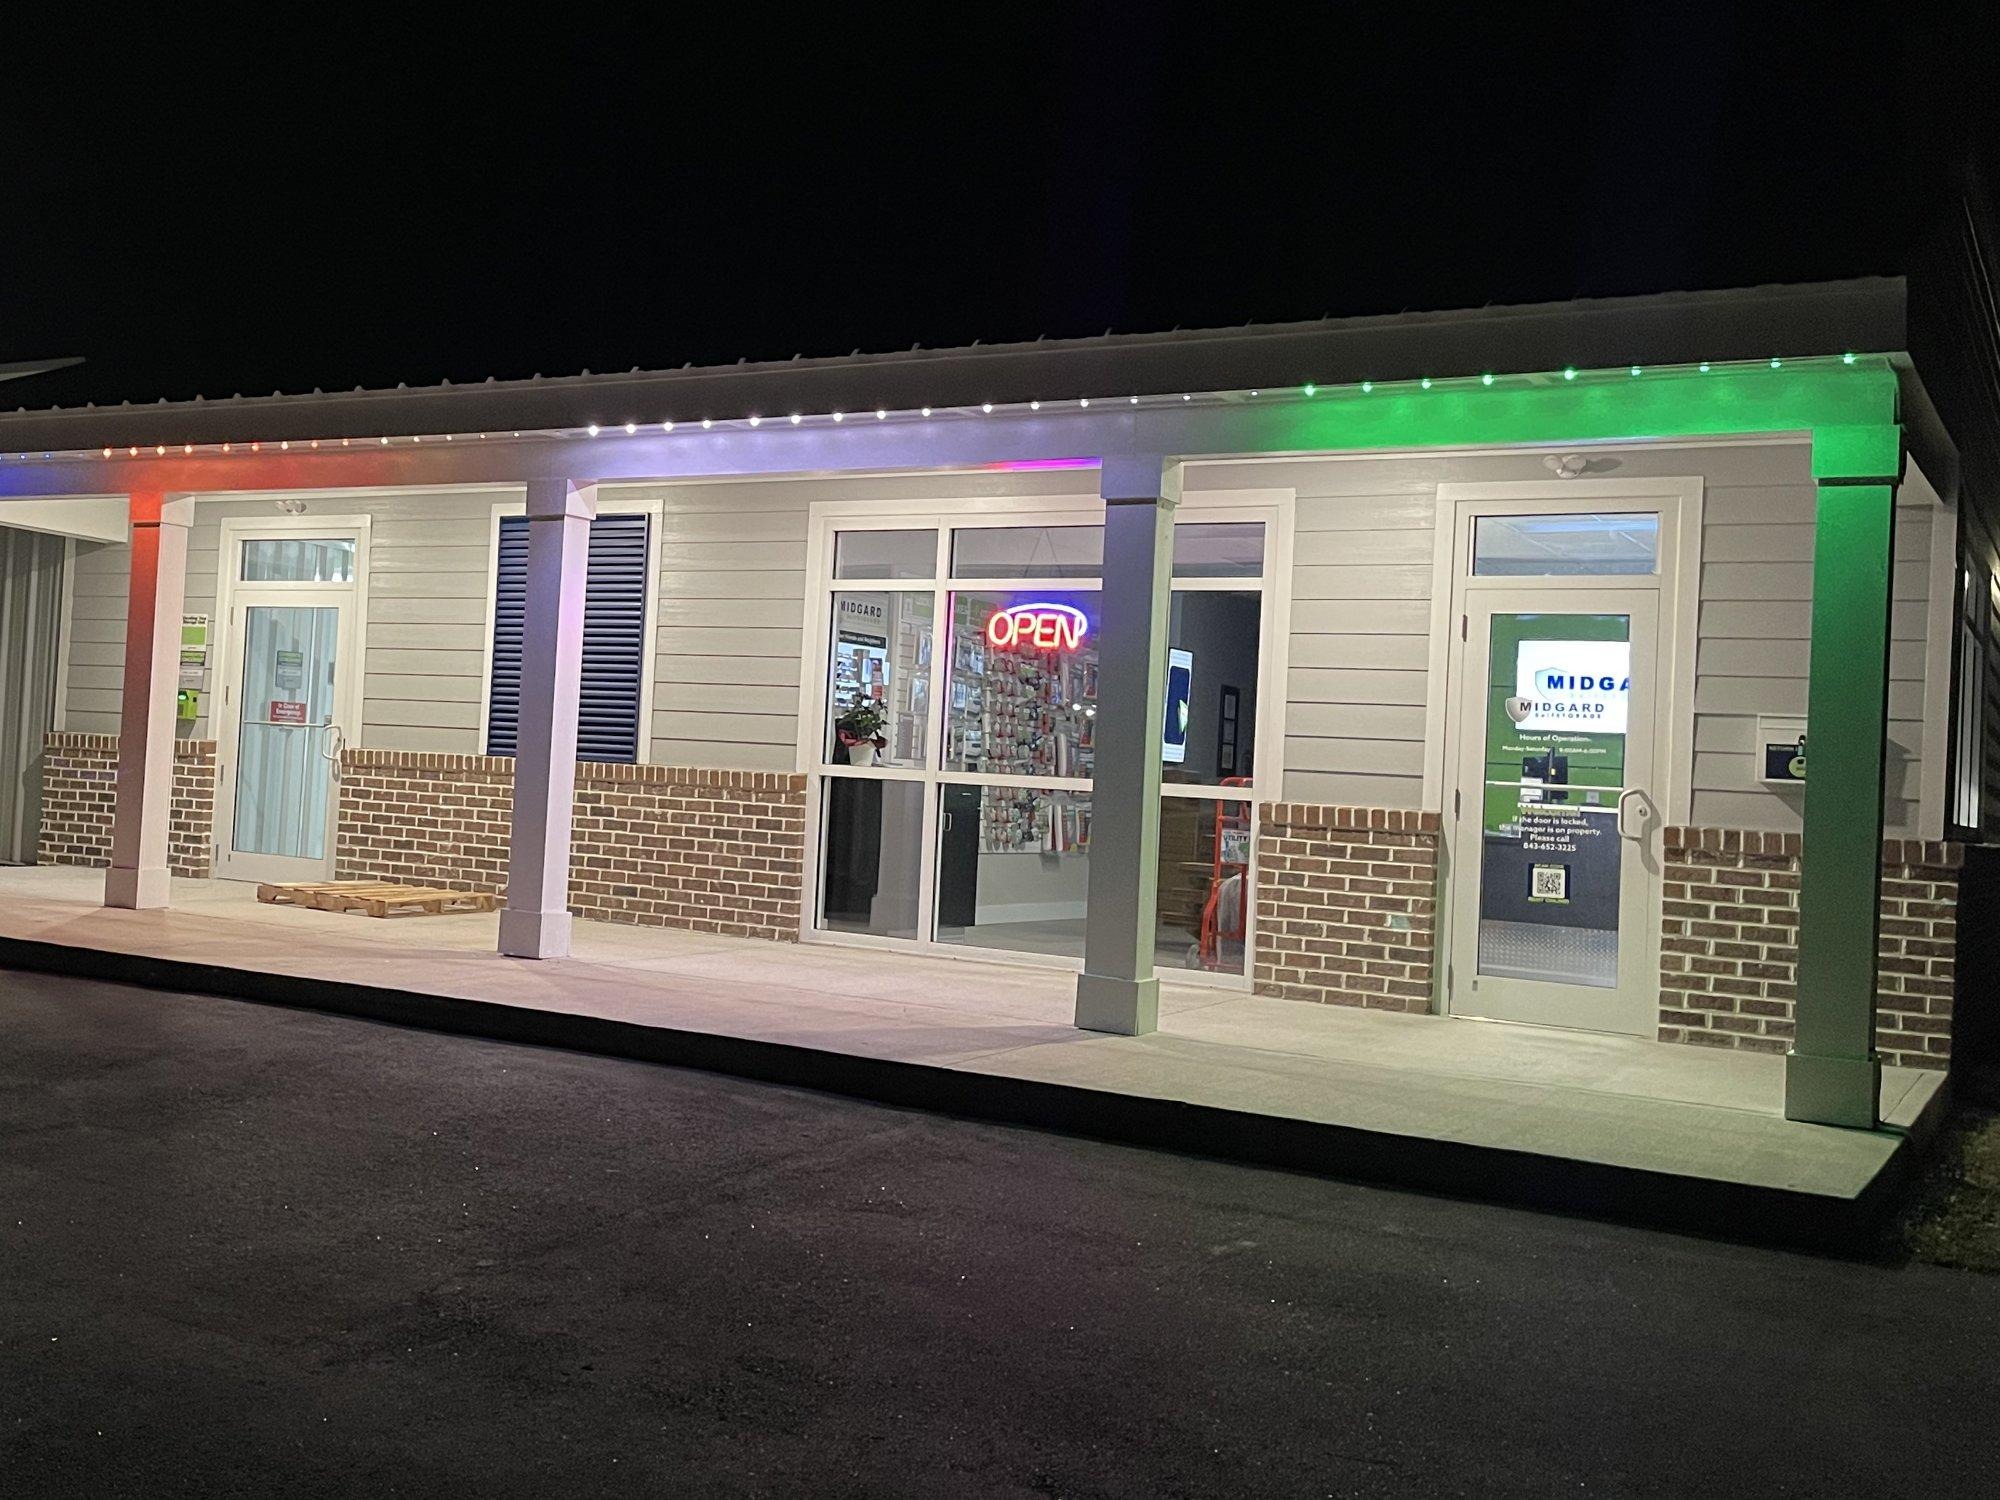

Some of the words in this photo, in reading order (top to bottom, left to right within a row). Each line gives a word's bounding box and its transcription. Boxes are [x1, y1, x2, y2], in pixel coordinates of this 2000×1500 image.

[840, 600, 882, 618] MIDGARD
[988, 611, 1080, 649] OPEN
[1547, 675, 1629, 691] MIDGA
[1520, 702, 1604, 713] MIDGARD
[1530, 834, 1555, 842] Please
